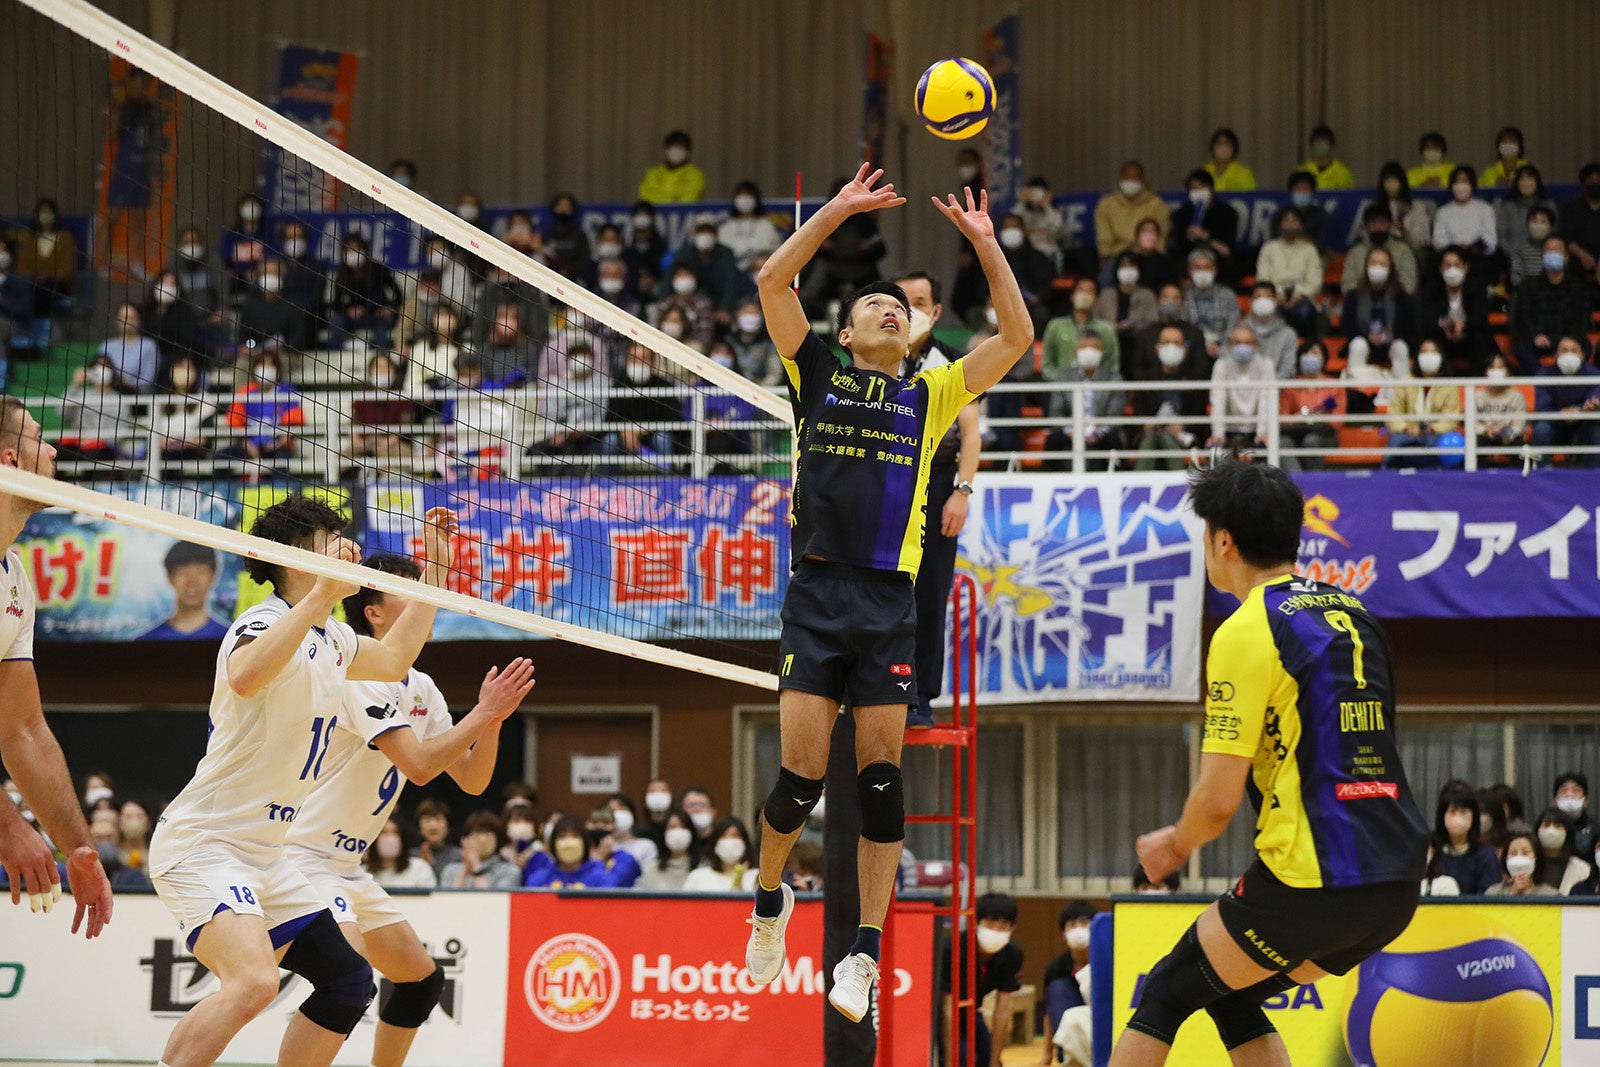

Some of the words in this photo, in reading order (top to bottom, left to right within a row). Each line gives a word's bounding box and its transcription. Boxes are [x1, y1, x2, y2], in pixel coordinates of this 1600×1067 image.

[865, 376, 887, 402] 17
[884, 402, 916, 418] STEEL
[816, 422, 855, 437] 甲南大学
[861, 428, 918, 447] SANKYU
[1391, 504, 1600, 581] ファイ
[612, 528, 774, 604] 直伸
[1323, 609, 1368, 690] 7
[371, 764, 399, 816] 9
[229, 885, 256, 905] 18
[334, 896, 347, 912] 9
[1244, 929, 1290, 967] BLAZERS
[1456, 954, 1516, 980] V200W
[630, 999, 750, 1022] ほっともっと
